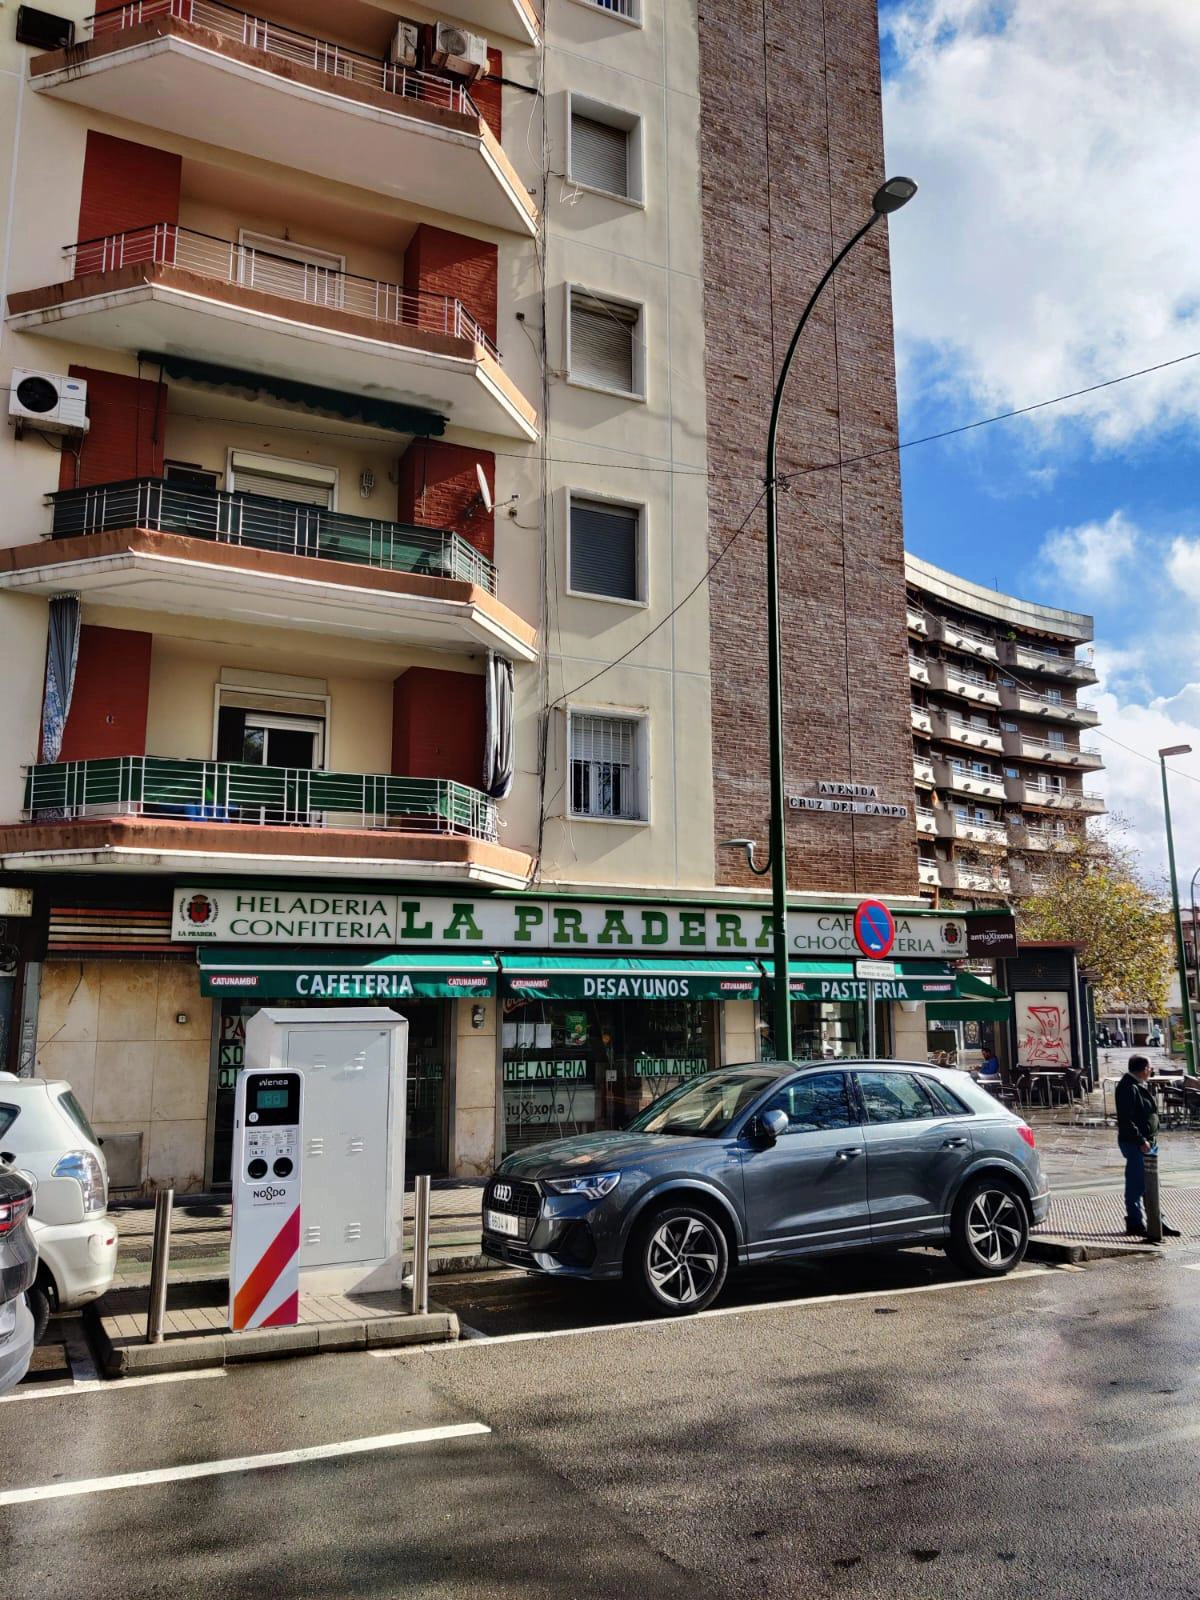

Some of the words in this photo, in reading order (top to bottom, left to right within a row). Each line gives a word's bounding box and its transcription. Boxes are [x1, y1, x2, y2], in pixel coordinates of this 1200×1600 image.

[820, 783, 876, 797] AVENIDA
[790, 797, 824, 810] CRUZ
[832, 802, 856, 813] DEL
[865, 804, 907, 817] CAMPO
[236, 895, 388, 916] HELADERIA
[229, 918, 392, 939] CONFITERIA
[401, 901, 484, 940] LA
[817, 917, 912, 934] CAFIA
[295, 974, 415, 995] CAFETERIA
[583, 978, 689, 997] DESAYUNOS
[821, 981, 909, 999] PASTEERIA
[506, 1061, 585, 1080] HELADERIA
[635, 1059, 706, 1076] CHOCOLATERIA
